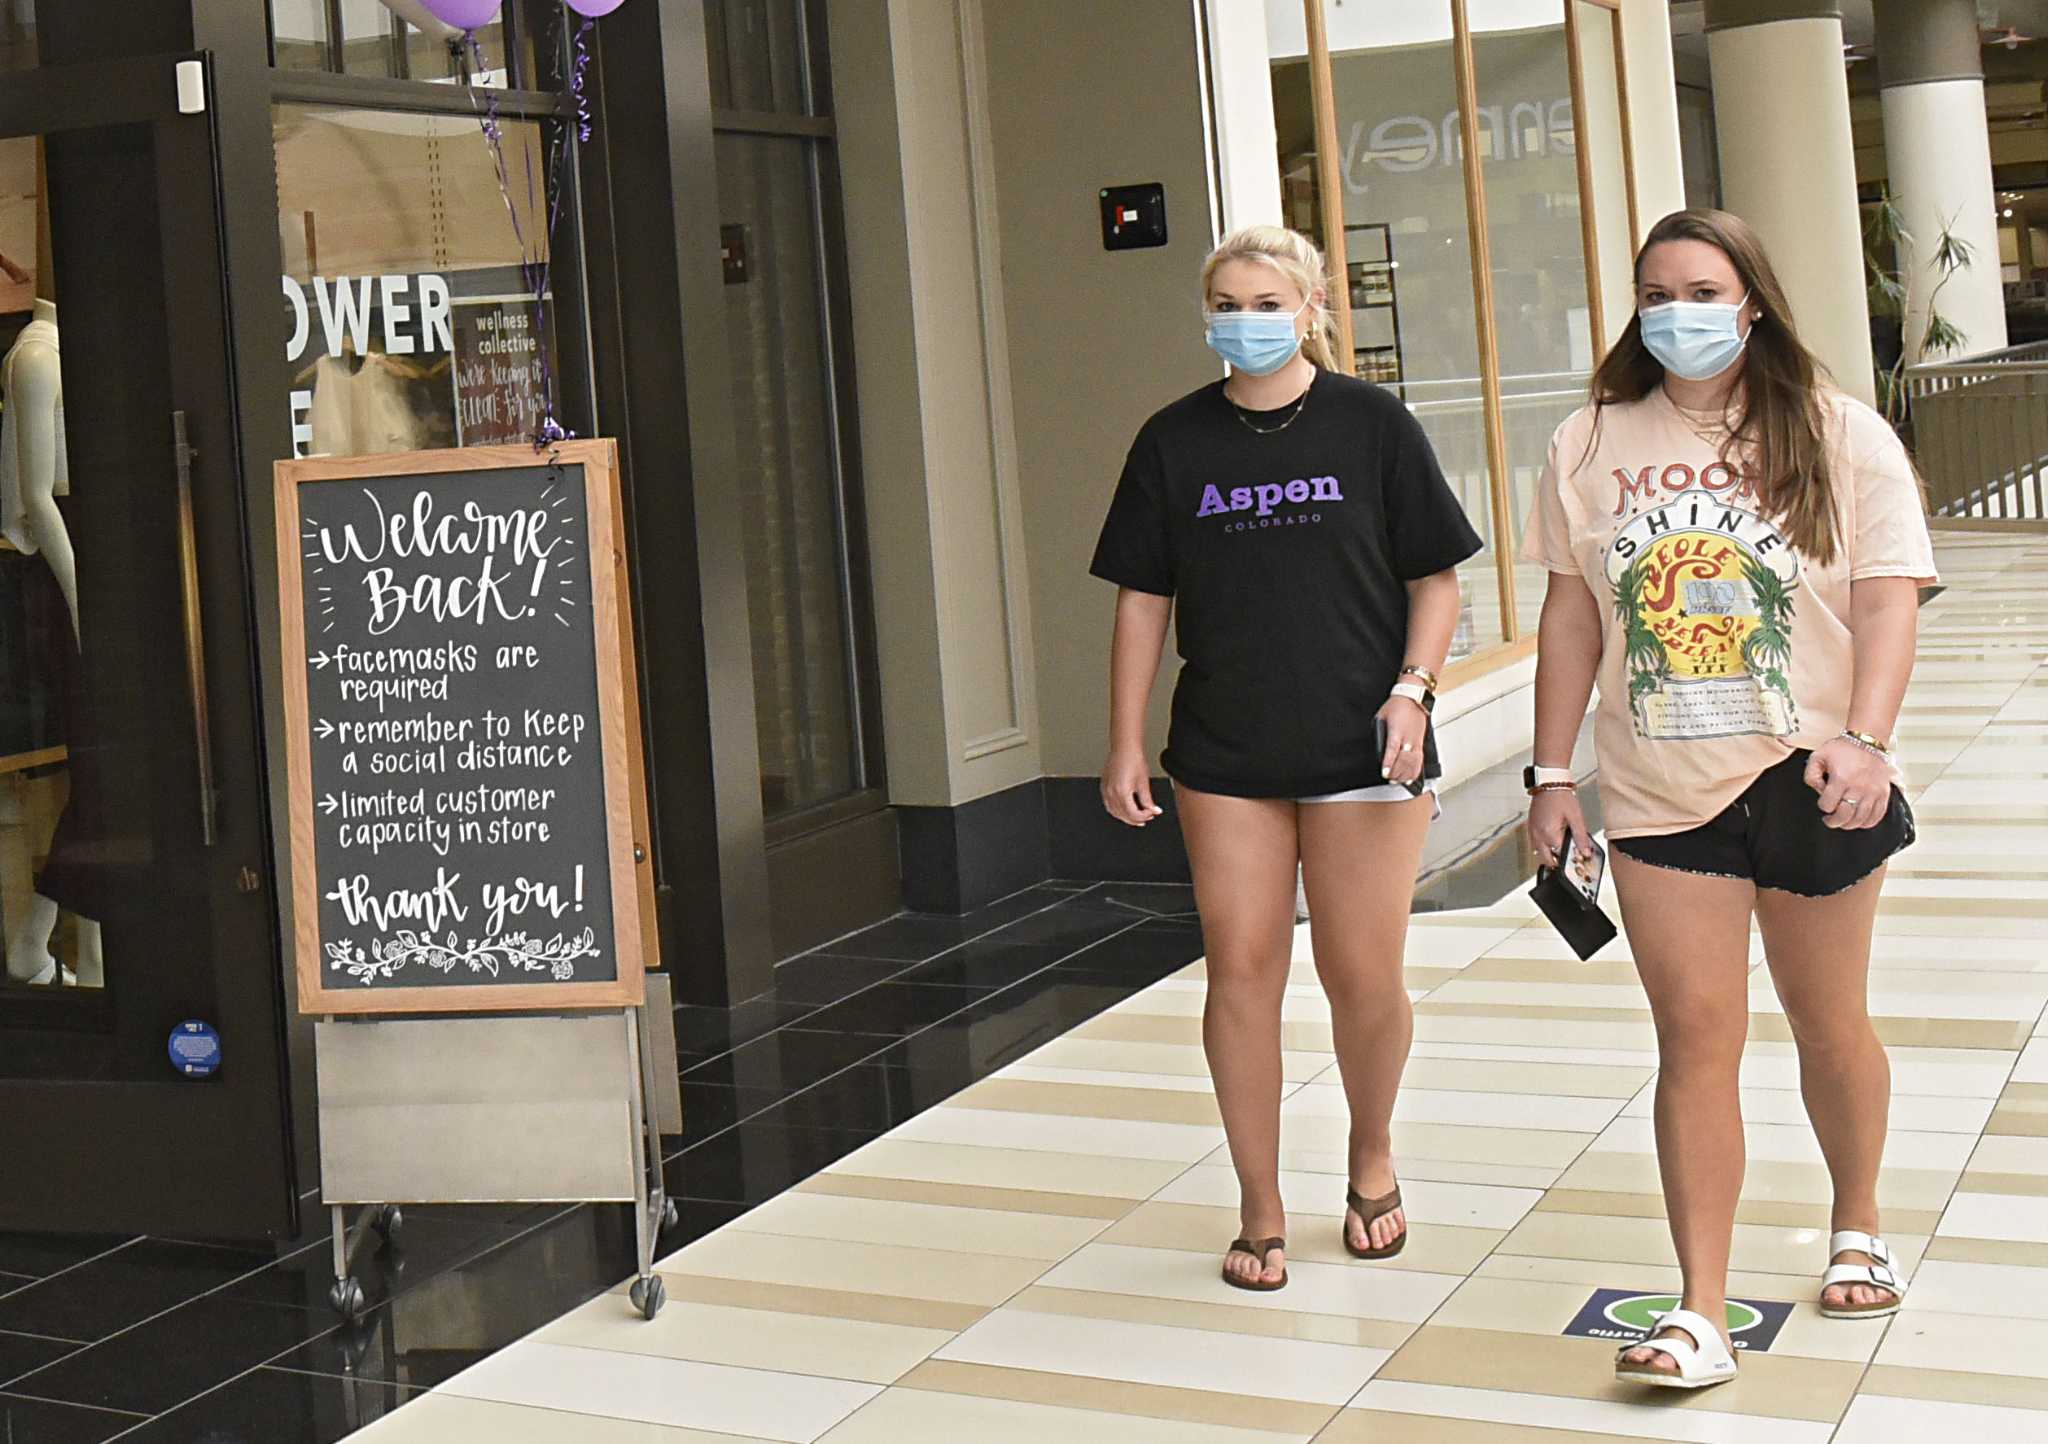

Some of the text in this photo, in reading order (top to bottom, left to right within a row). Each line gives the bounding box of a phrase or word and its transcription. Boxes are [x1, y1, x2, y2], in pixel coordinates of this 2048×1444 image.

[476, 309, 528, 332] wellness
[478, 333, 536, 354] collective
[1196, 475, 1344, 518] Aspen
[320, 488, 561, 565] Welcome
[1224, 513, 1321, 533] COLORADO
[1614, 503, 1782, 559] SHINE
[362, 555, 547, 635] Back!
[333, 640, 540, 673] facemasks are
[340, 674, 448, 712] required
[339, 712, 473, 744] remember
[482, 710, 510, 740] to
[342, 740, 572, 774] a social distance
[341, 784, 556, 818] limited customer
[339, 816, 551, 855] capacity in store
[325, 867, 468, 933] thank
